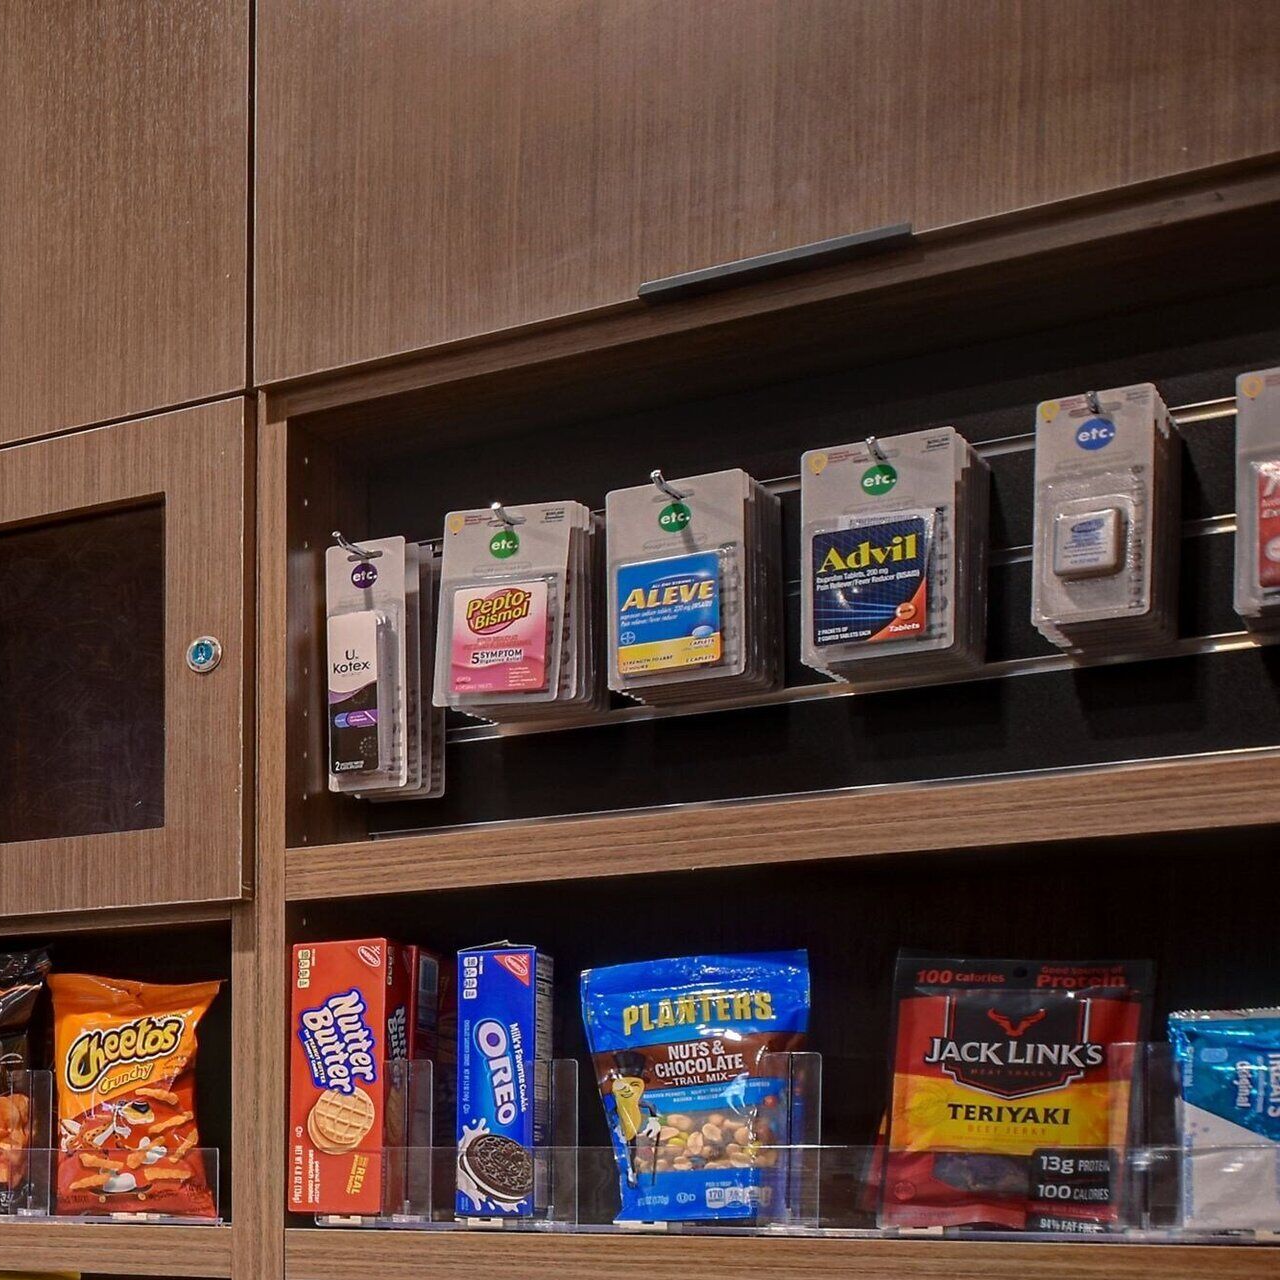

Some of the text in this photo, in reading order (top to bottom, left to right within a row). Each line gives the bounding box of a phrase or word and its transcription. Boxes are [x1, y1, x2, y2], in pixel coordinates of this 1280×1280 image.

[1078, 428, 1114, 441] etc.
[864, 472, 895, 487] etc.
[660, 511, 691, 524] etc.
[492, 539, 519, 549] etc.
[817, 534, 916, 574] Advil
[353, 572, 377, 581] etc.
[468, 590, 530, 618] Pepto-
[621, 580, 714, 611] ALEVE
[474, 605, 527, 629] Bismol
[889, 623, 920, 632] Tablets
[333, 660, 369, 674] kotex
[472, 649, 522, 664] 5 SYMPTOM
[917, 970, 1005, 984] 100 Calories
[623, 991, 772, 1036] PLANTERS
[328, 990, 376, 1085] Nutter
[66, 1018, 186, 1090] Cheetos
[303, 1007, 349, 1093] Butter
[668, 1040, 725, 1060] NUTS &
[925, 1038, 1103, 1067] JACK LINK'S
[476, 1021, 516, 1125] OREO
[654, 1054, 744, 1078] CHOCOLATE
[98, 1063, 152, 1094] Crunchy
[672, 1072, 728, 1086] TRAIL MIX
[948, 1103, 1070, 1125] TERIYAKI
[1040, 1155, 1110, 1174] 13g PROTEIN
